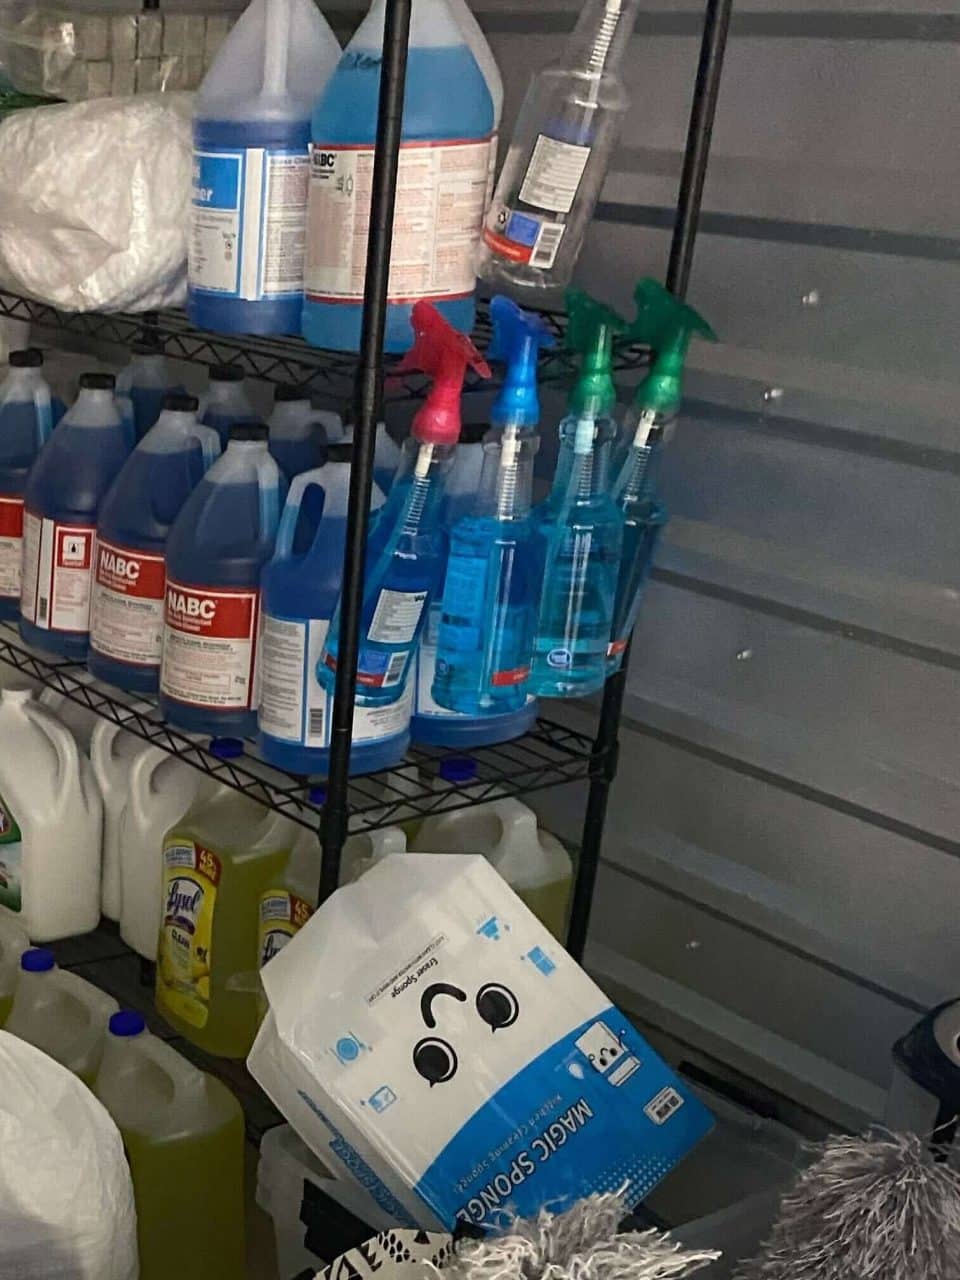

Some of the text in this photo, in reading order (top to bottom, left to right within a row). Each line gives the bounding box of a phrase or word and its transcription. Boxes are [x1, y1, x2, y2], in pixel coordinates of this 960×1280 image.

[101, 549, 140, 579] NABC
[168, 590, 216, 619] NABC
[391, 957, 439, 998] Eraser Sponge
[532, 1098, 594, 1161] MAGIC
